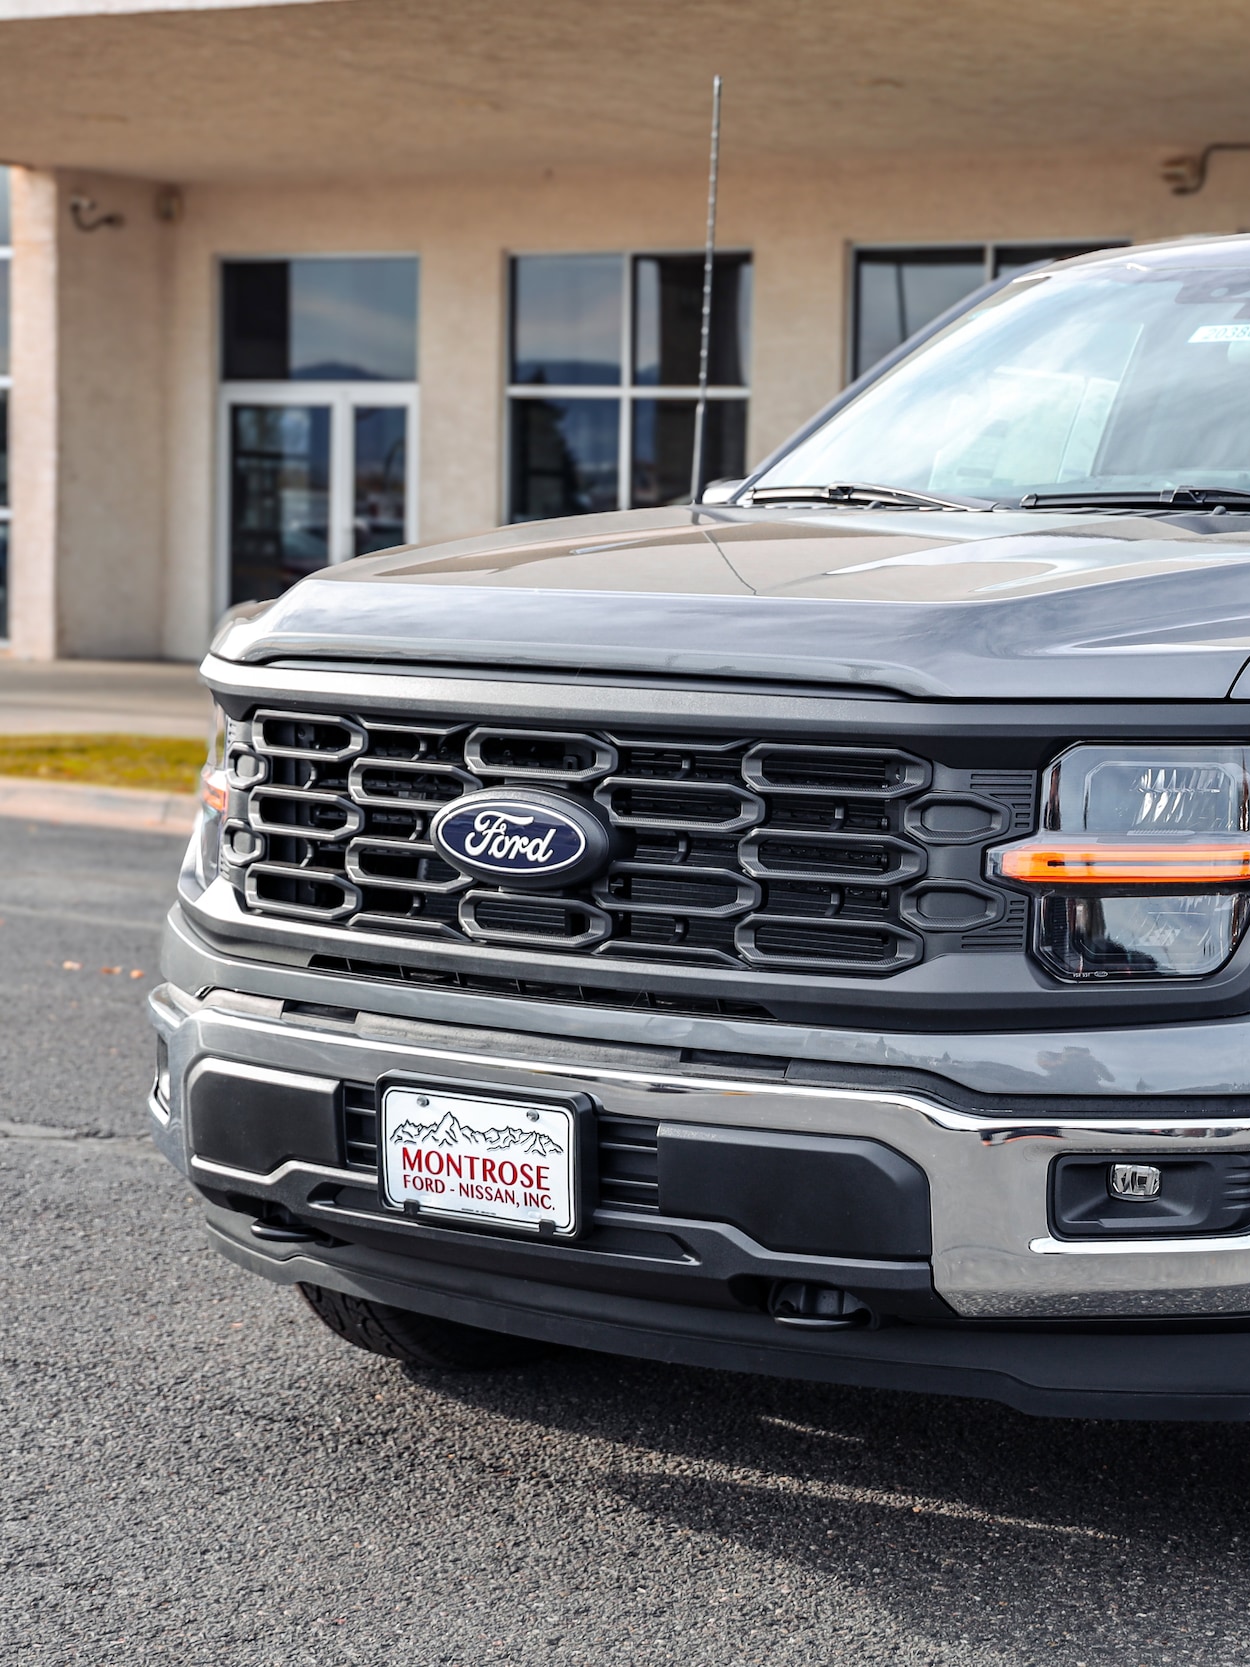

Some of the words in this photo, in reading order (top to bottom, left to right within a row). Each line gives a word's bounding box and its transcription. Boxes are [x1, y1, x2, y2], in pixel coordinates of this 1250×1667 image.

[465, 810, 557, 863] Ford
[402, 1147, 550, 1191] MONTROSE
[403, 1175, 445, 1194] FORD
[459, 1183, 520, 1208] NISSAN,
[524, 1192, 555, 1210] INC.
